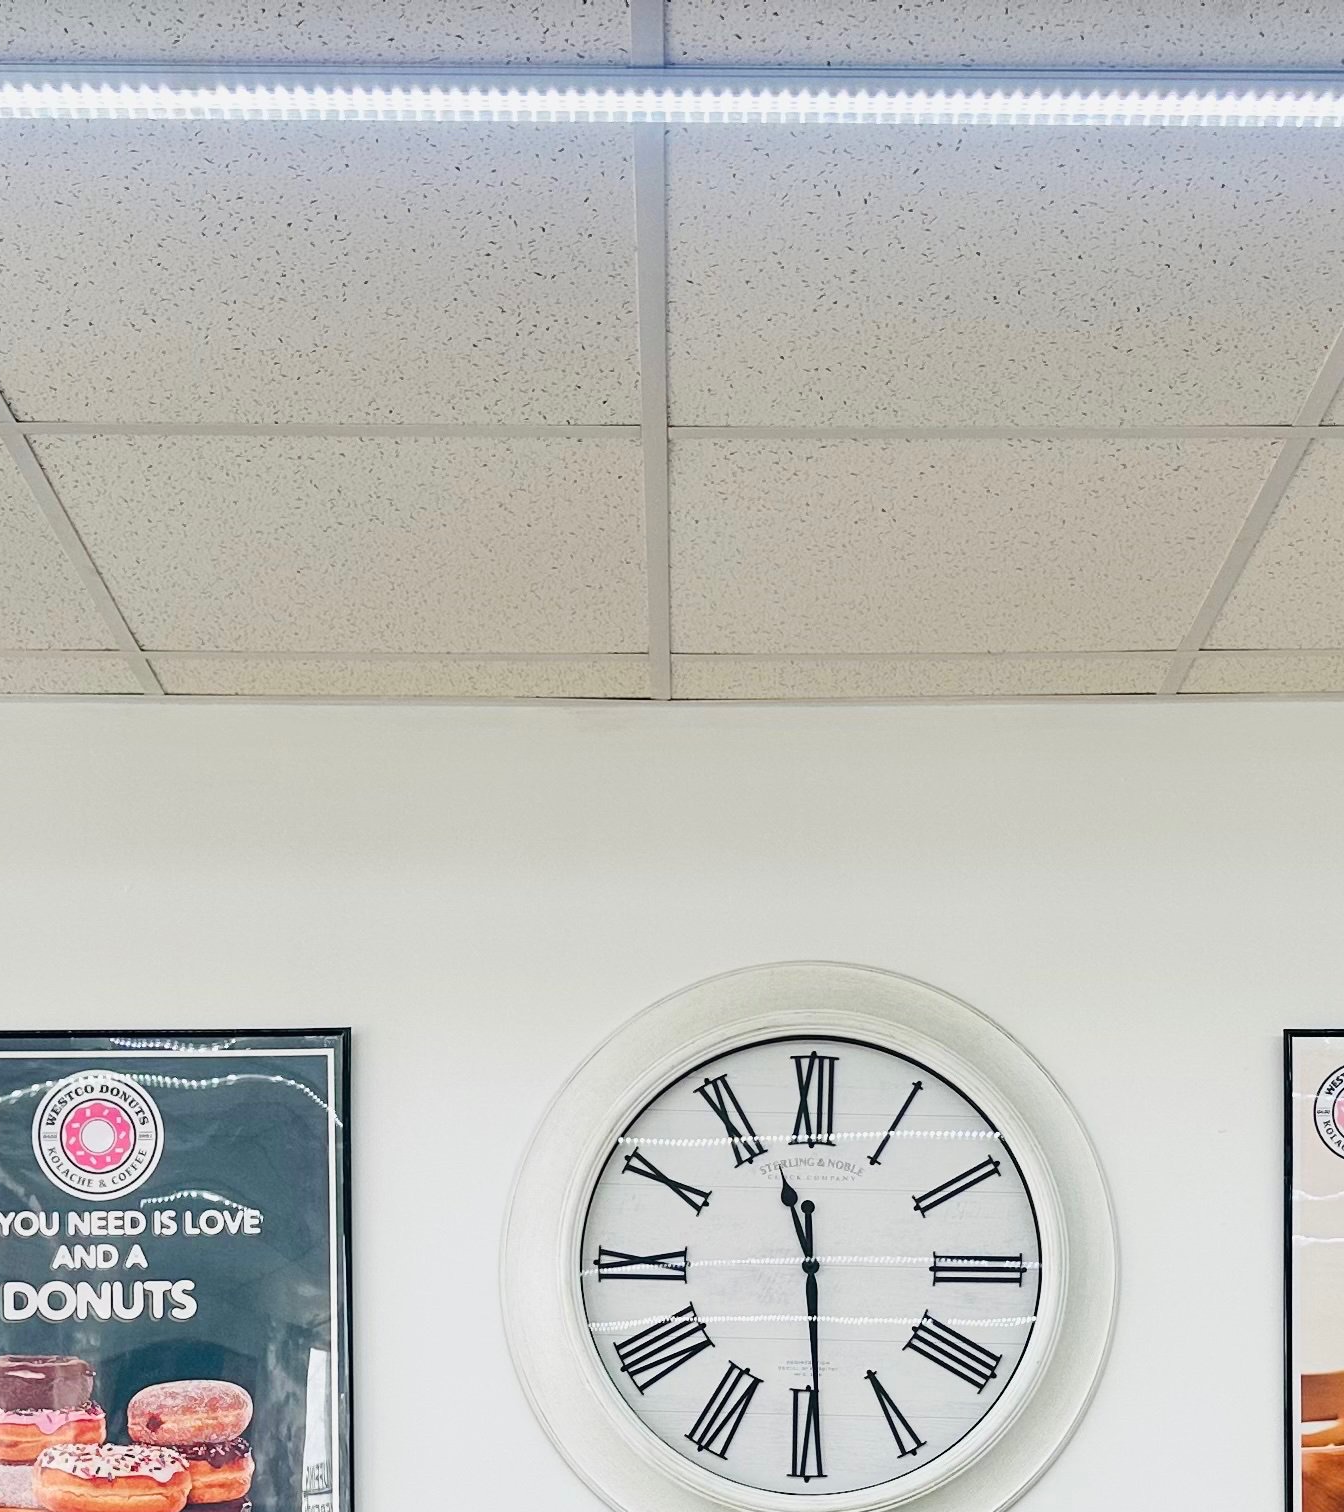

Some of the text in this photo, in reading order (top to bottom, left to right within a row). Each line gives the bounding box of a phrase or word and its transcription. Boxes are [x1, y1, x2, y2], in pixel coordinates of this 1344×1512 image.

[46, 1084, 150, 1127] WESTCO DONUTS
[693, 1073, 768, 1168] XI
[790, 1051, 840, 1148] XII
[48, 1147, 147, 1188] KOLACHE & COFFEE
[622, 1147, 712, 1216] X
[759, 1157, 865, 1177] STERLING & NOBLE
[67, 1210, 147, 1237] NEED
[153, 1210, 178, 1237] IS
[184, 1209, 262, 1236] LOVE
[50, 1244, 149, 1271] AND A
[929, 1251, 1027, 1286] III
[1, 1280, 198, 1322] DONUTS
[865, 1370, 926, 1459] V
